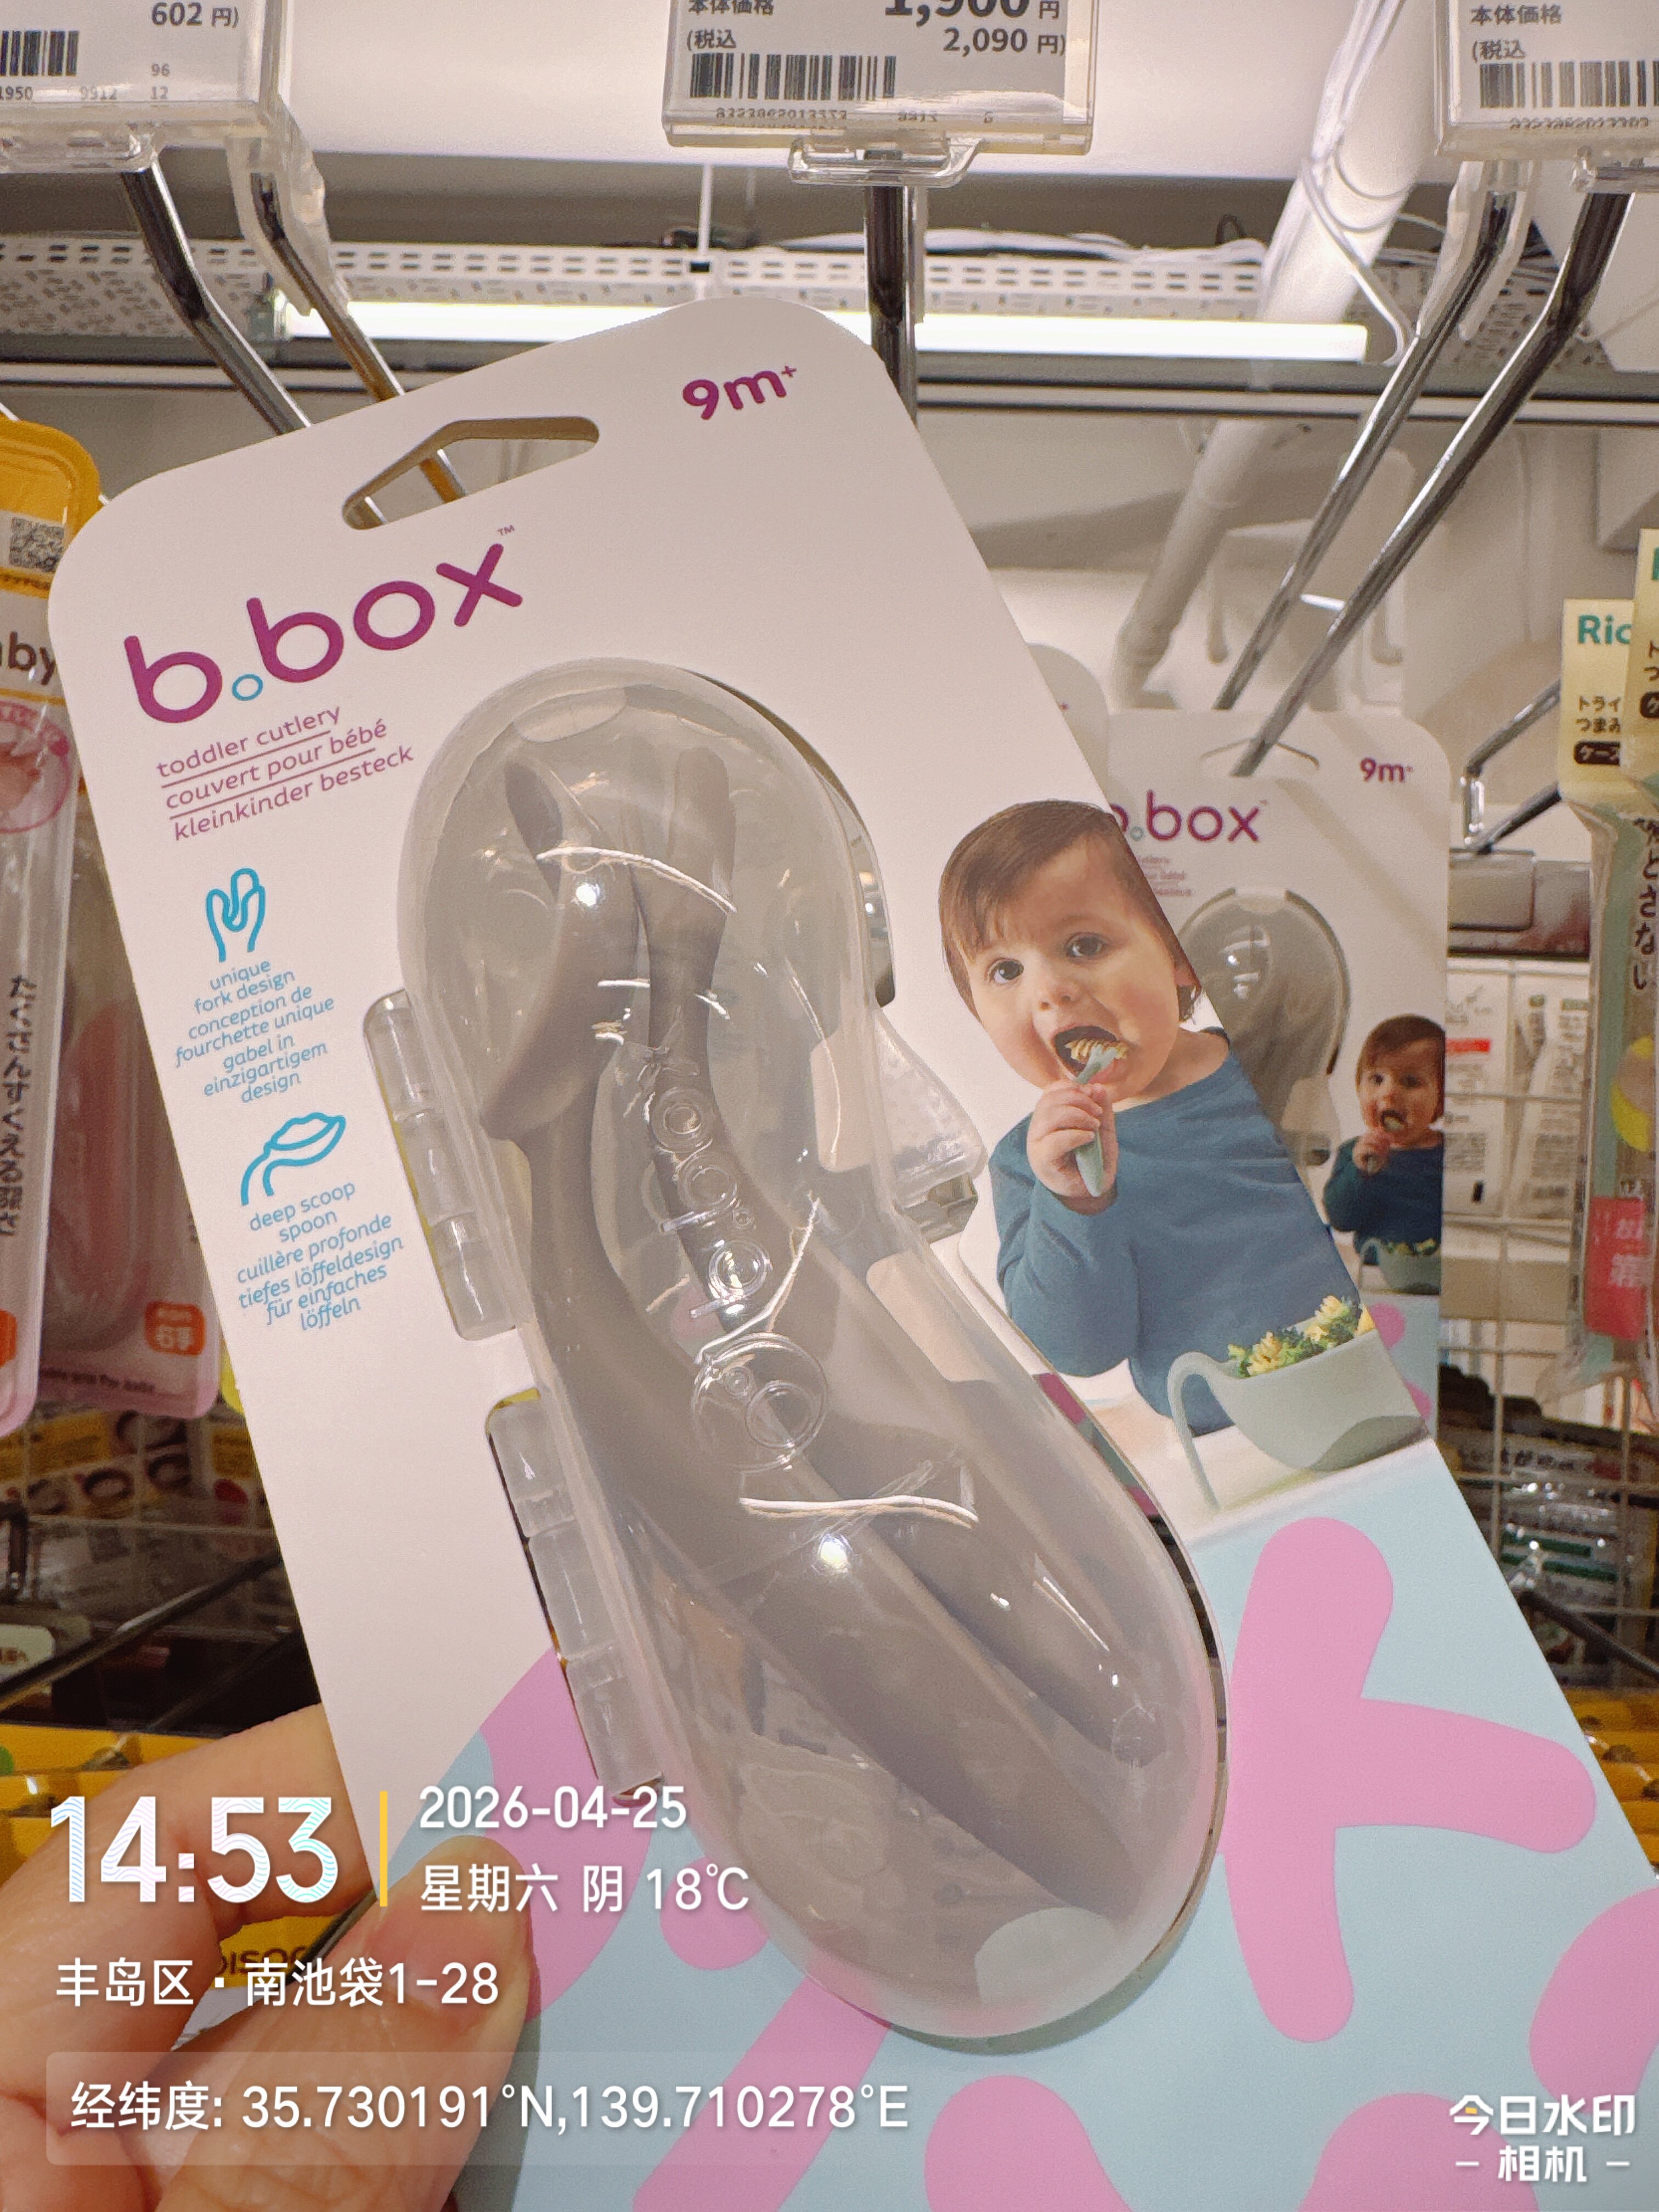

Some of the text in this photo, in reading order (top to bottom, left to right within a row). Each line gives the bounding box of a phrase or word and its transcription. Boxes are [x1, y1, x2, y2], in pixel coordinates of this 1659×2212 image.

[151, 2, 202, 26] 602
[1471, 4, 1562, 26] 本体価格
[687, 29, 736, 51] (税込
[943, 27, 1028, 57] 2,090
[1472, 40, 1526, 63] (税込
[151, 63, 171, 76] 96
[156, 706, 340, 778] toddler cutlery
[166, 718, 387, 809] couvert pour bébé
[174, 745, 414, 842] kleinkinder besteck
[194, 971, 296, 1015] fork design
[210, 960, 272, 991] unique
[175, 998, 334, 1069] fourchette unique
[188, 986, 313, 1040] conception de
[204, 1043, 328, 1097] einzigartigem
[222, 1034, 295, 1074] gabel in
[241, 1073, 301, 1103] design
[250, 1182, 356, 1231] deep scoop
[279, 1211, 337, 1243] spoon
[237, 1214, 392, 1284] cuillère profonde
[238, 1237, 404, 1310] tiefes löffeldesign
[266, 1265, 387, 1326] für einfaches
[300, 1297, 362, 1331] löffeln
